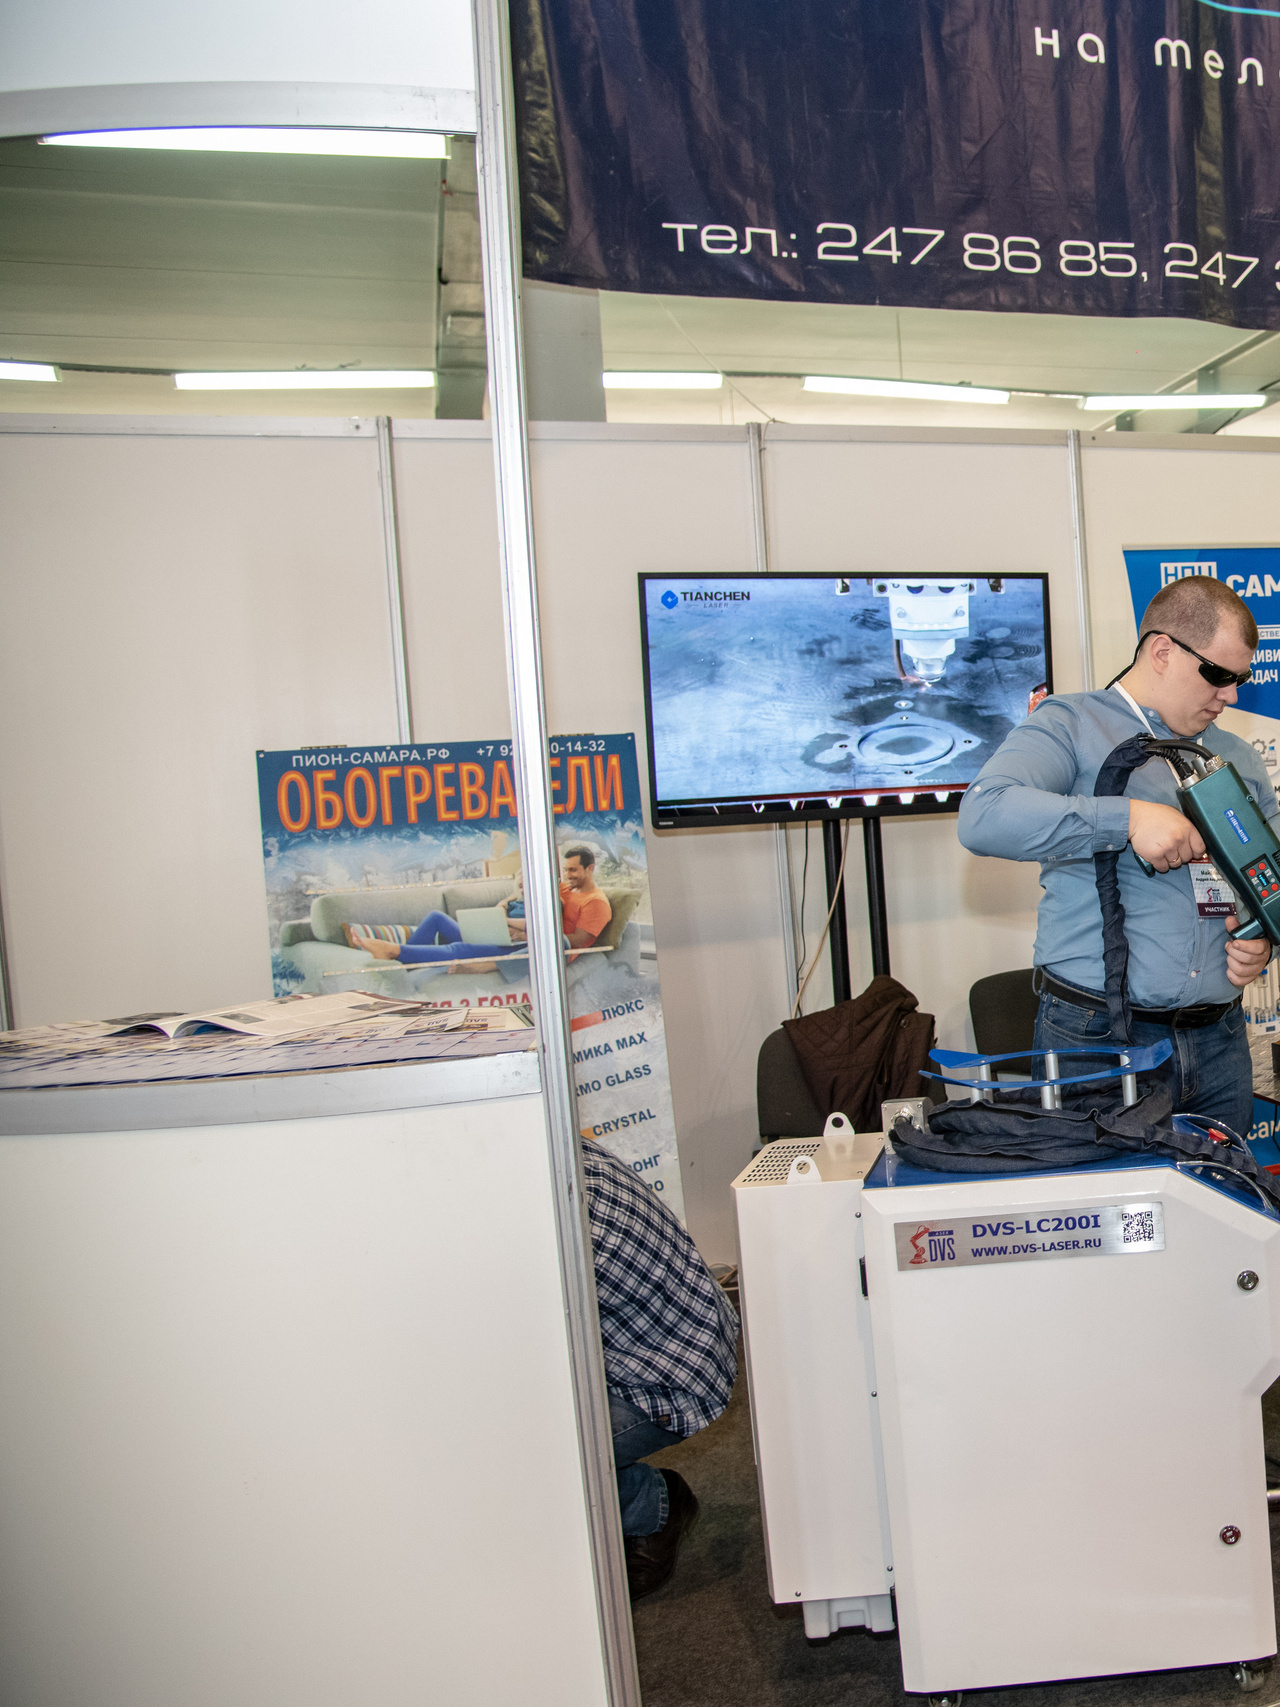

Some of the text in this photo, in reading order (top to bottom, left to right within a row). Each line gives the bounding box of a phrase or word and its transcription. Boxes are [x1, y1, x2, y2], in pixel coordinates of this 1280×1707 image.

[1035, 26, 1105, 63] на
[662, 222, 798, 259] тел.:
[816, 222, 946, 266] 247
[962, 232, 1042, 274] 86
[1059, 239, 1148, 283] 85,
[1164, 241, 1260, 290] 247
[680, 591, 751, 602] TIANCHEN
[292, 747, 450, 767] ПИОН-САМАРА.РФ
[476, 745, 494, 757] +7
[550, 740, 606, 754] 0-14-32
[277, 753, 625, 833] ОБОГРЕВАЕЛИ
[601, 999, 645, 1021] ЛЮКС
[616, 1031, 648, 1051] MAX
[605, 1064, 652, 1087] GLASS
[592, 1108, 656, 1137] CRYSTAL
[628, 1154, 661, 1173] ОНГ
[972, 1214, 1101, 1238] DVS-LC200I
[929, 1237, 955, 1263] DVS
[971, 1238, 1102, 1258] WWW.DVS-LASER.RU
